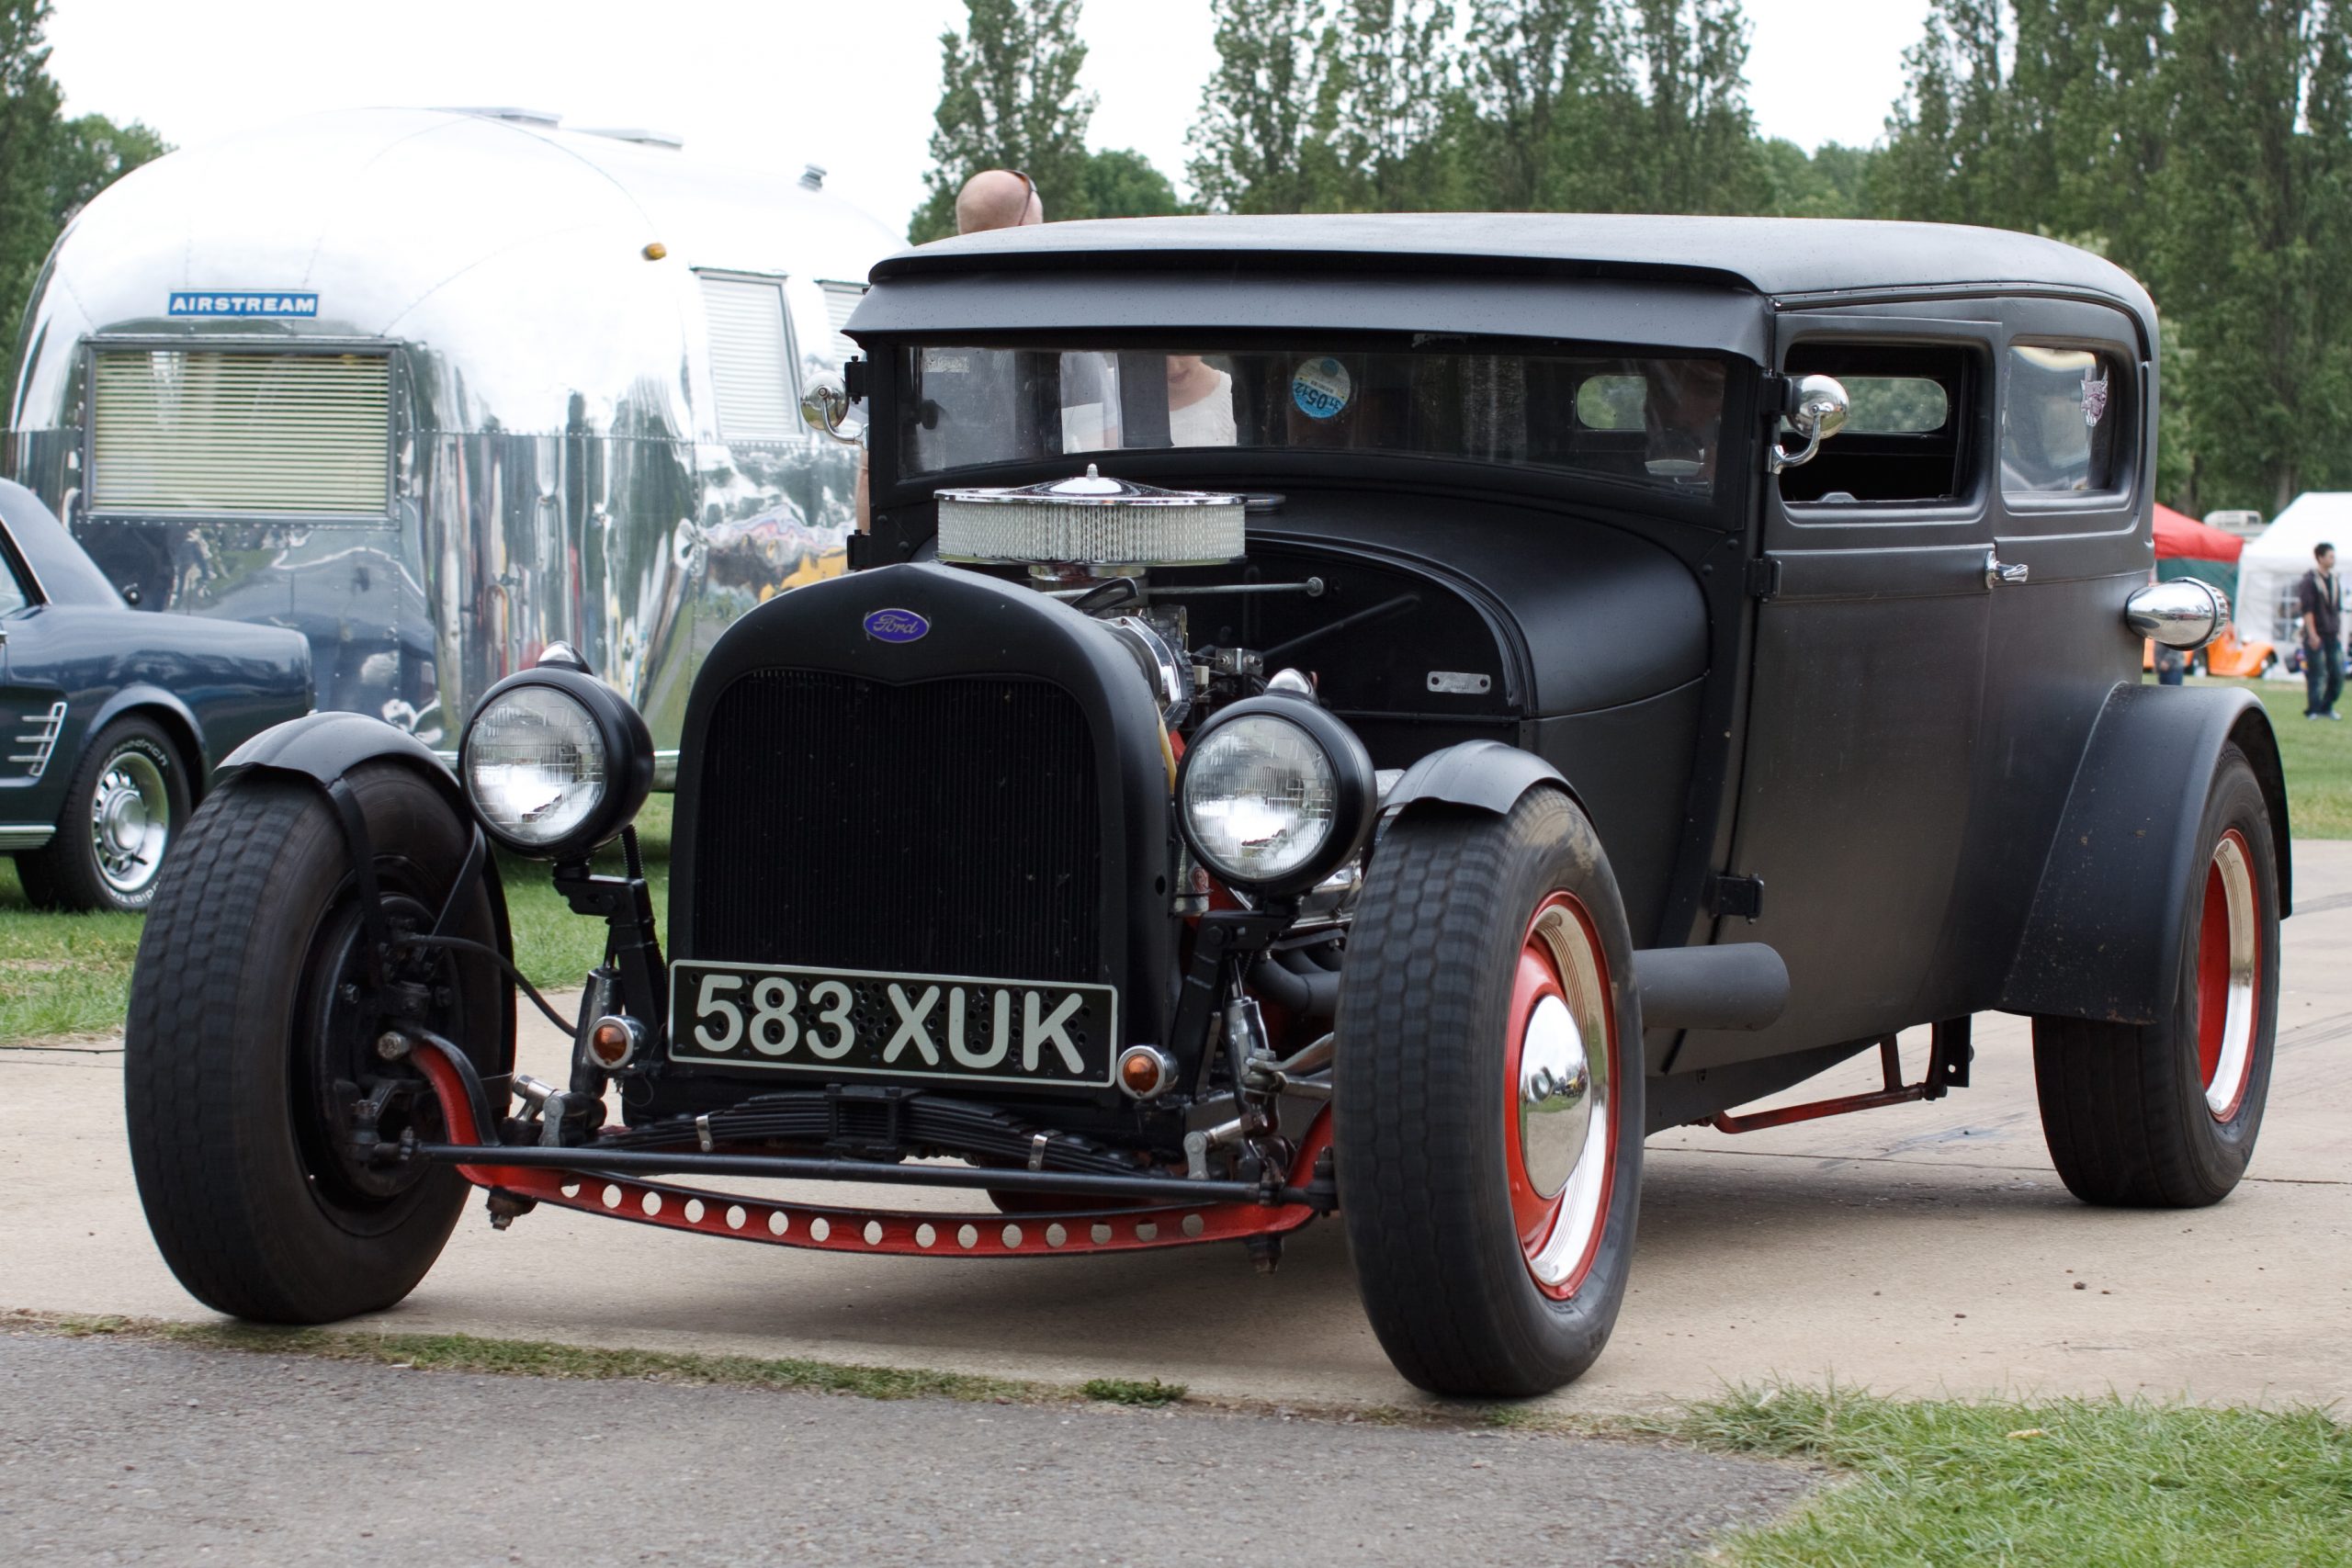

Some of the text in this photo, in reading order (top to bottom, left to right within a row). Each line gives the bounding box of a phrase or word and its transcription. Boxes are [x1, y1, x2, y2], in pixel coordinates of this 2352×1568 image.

[172, 297, 316, 313] AIRSTREAM
[873, 614, 919, 635] Ford
[694, 974, 1086, 1075] 583 XUK
